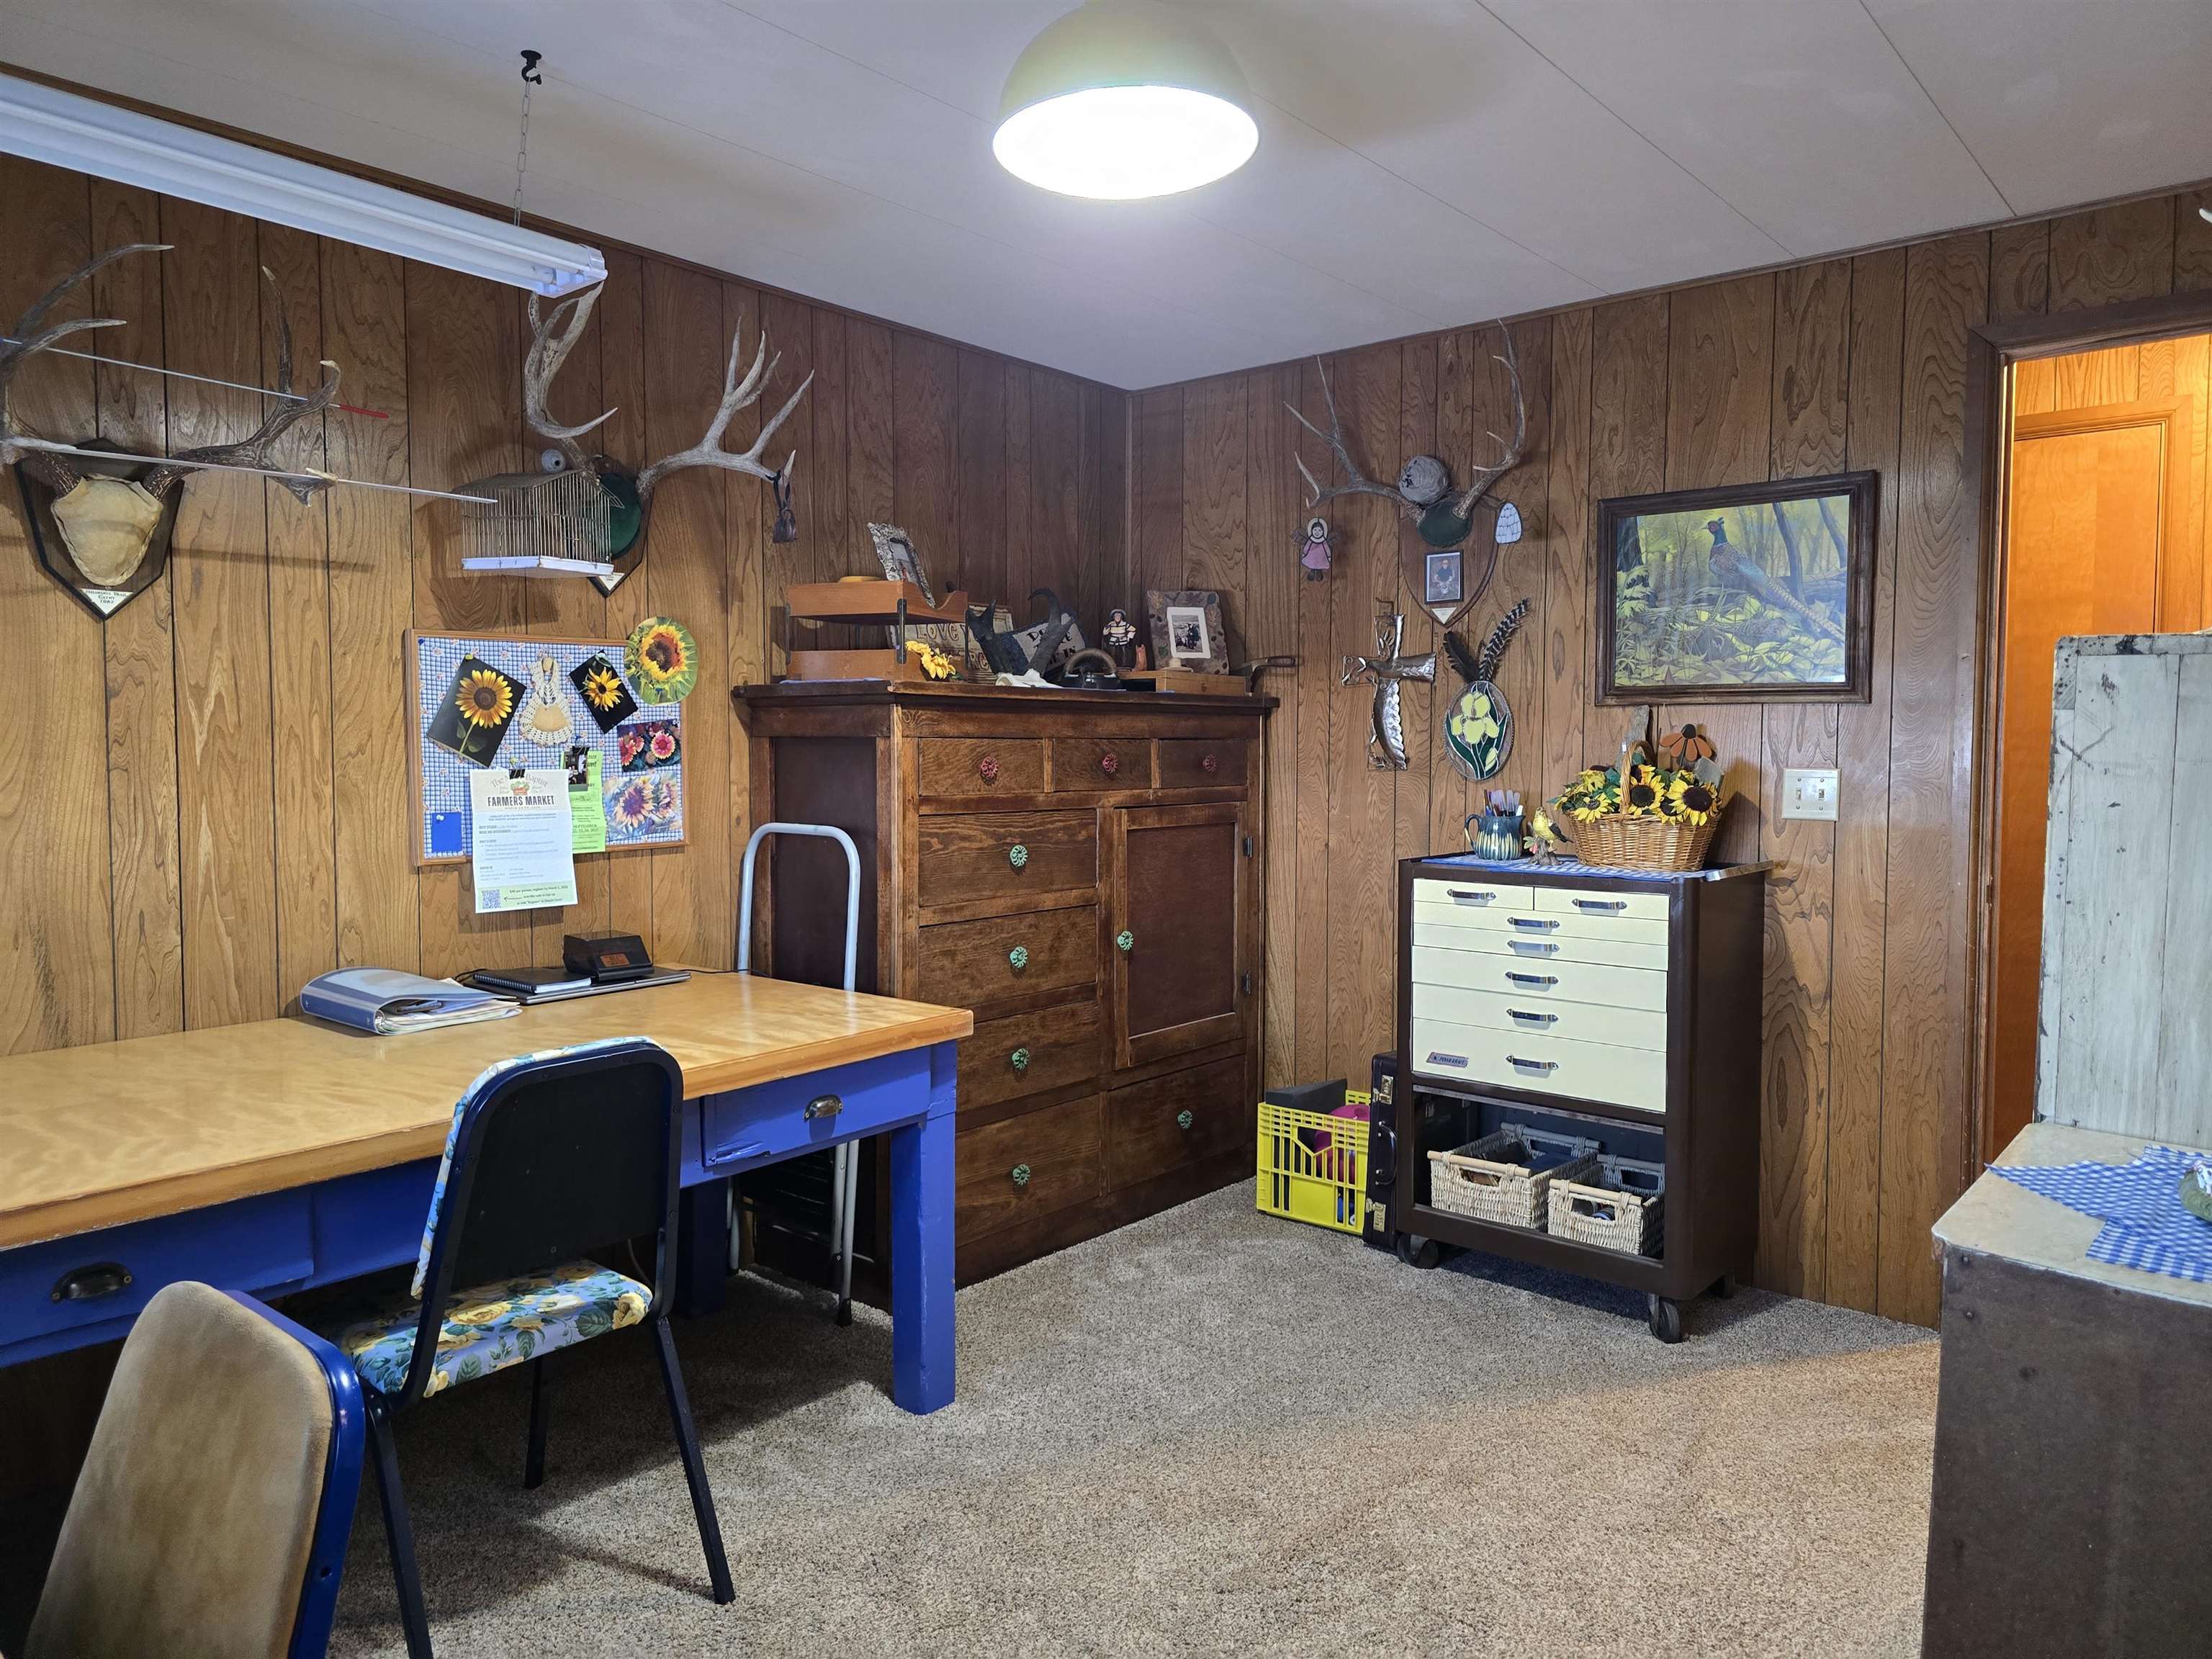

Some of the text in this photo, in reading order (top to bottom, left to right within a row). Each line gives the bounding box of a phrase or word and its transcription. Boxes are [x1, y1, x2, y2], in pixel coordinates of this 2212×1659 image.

[915, 623, 959, 642] LOVE
[487, 795, 554, 807] FARMERS MARKET
